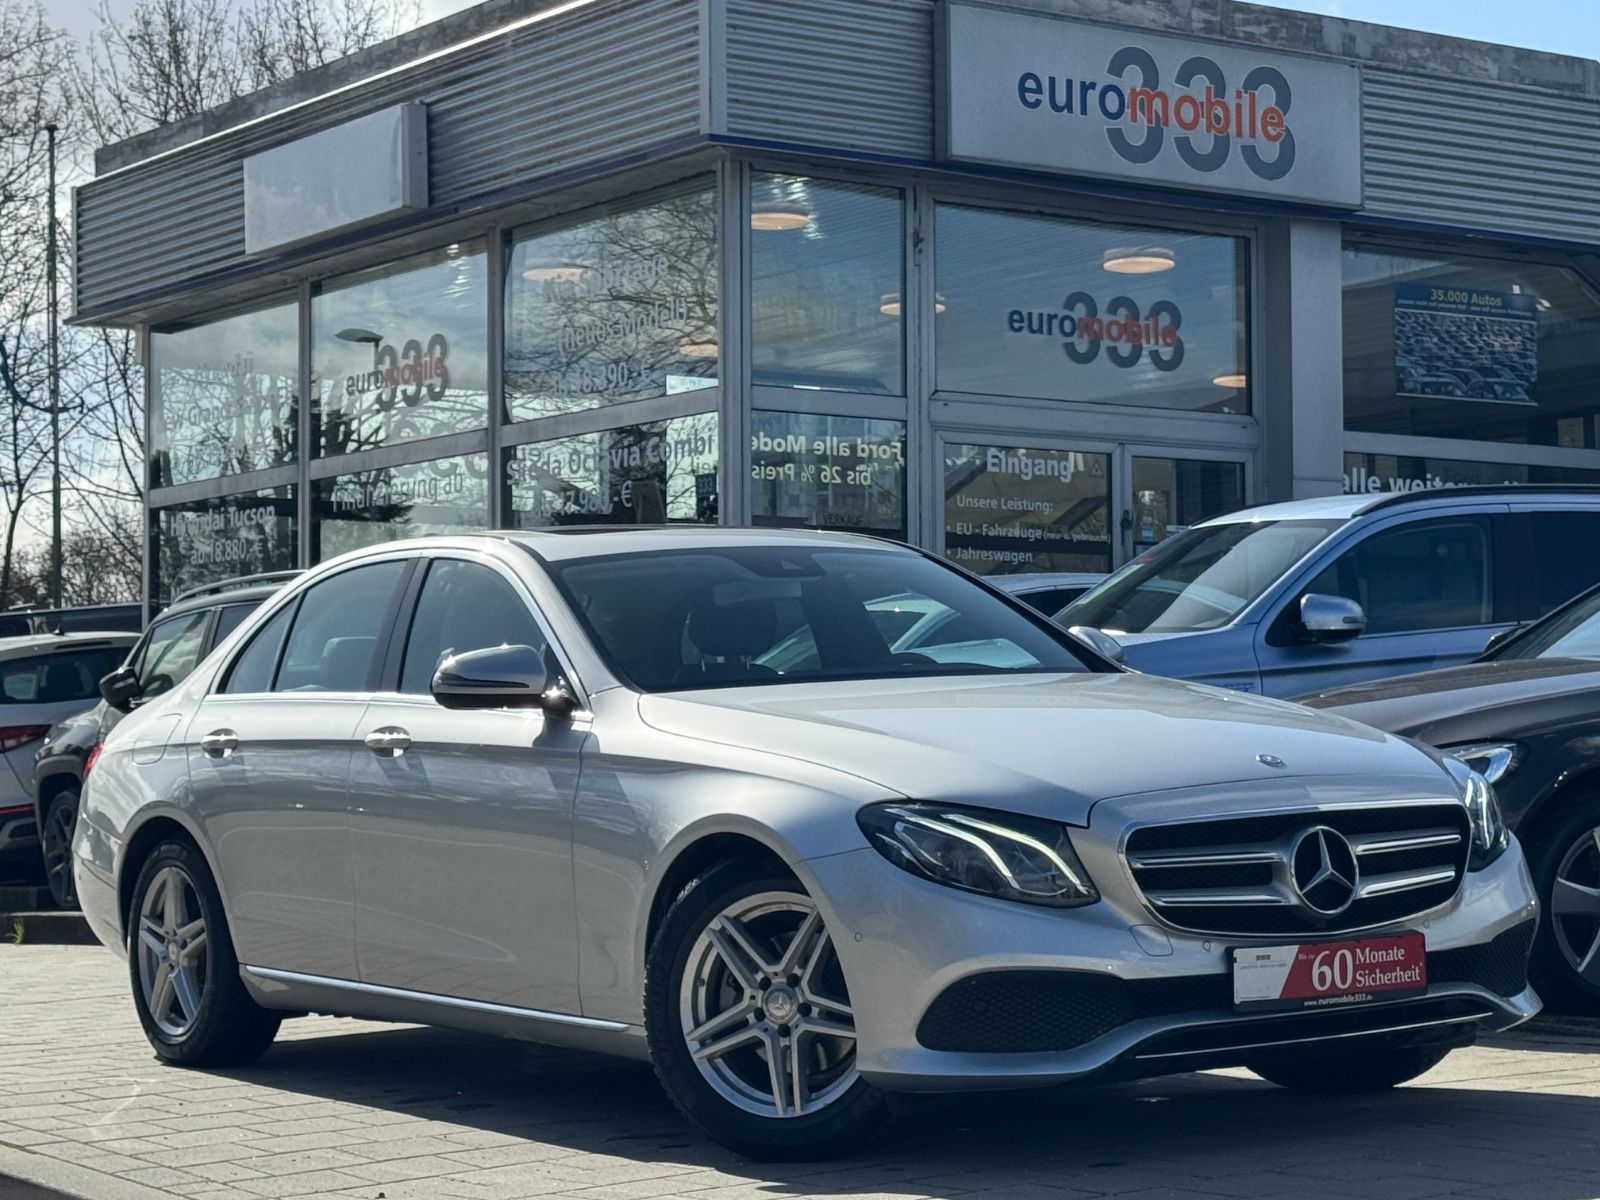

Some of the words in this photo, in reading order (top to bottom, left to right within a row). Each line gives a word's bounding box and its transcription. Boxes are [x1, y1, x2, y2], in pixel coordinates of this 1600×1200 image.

[1017, 71, 1286, 142] euromobile
[1105, 46, 1297, 181] 333
[1430, 288, 1468, 304] 35.000
[1471, 293, 1502, 307] Autos
[1008, 309, 1177, 347] euromobile
[1063, 291, 1184, 372] 333
[346, 352, 445, 395] euromobile
[375, 333, 448, 412] 333
[647, 428, 713, 462] Combi
[987, 448, 1073, 483] Eingang
[621, 479, 633, 508] €
[956, 495, 998, 509] Unsere
[1001, 498, 1053, 516] Leistung:
[171, 507, 225, 537] Hyundai
[228, 505, 276, 527] Tucson
[956, 523, 973, 536] EU
[982, 523, 1042, 542] Fahrzeuge
[191, 549, 205, 565] ab
[955, 547, 1033, 565] Jahreswagen
[1312, 949, 1354, 991] 60
[1356, 946, 1405, 964] Monate
[1356, 965, 1420, 987] Sicherheit
